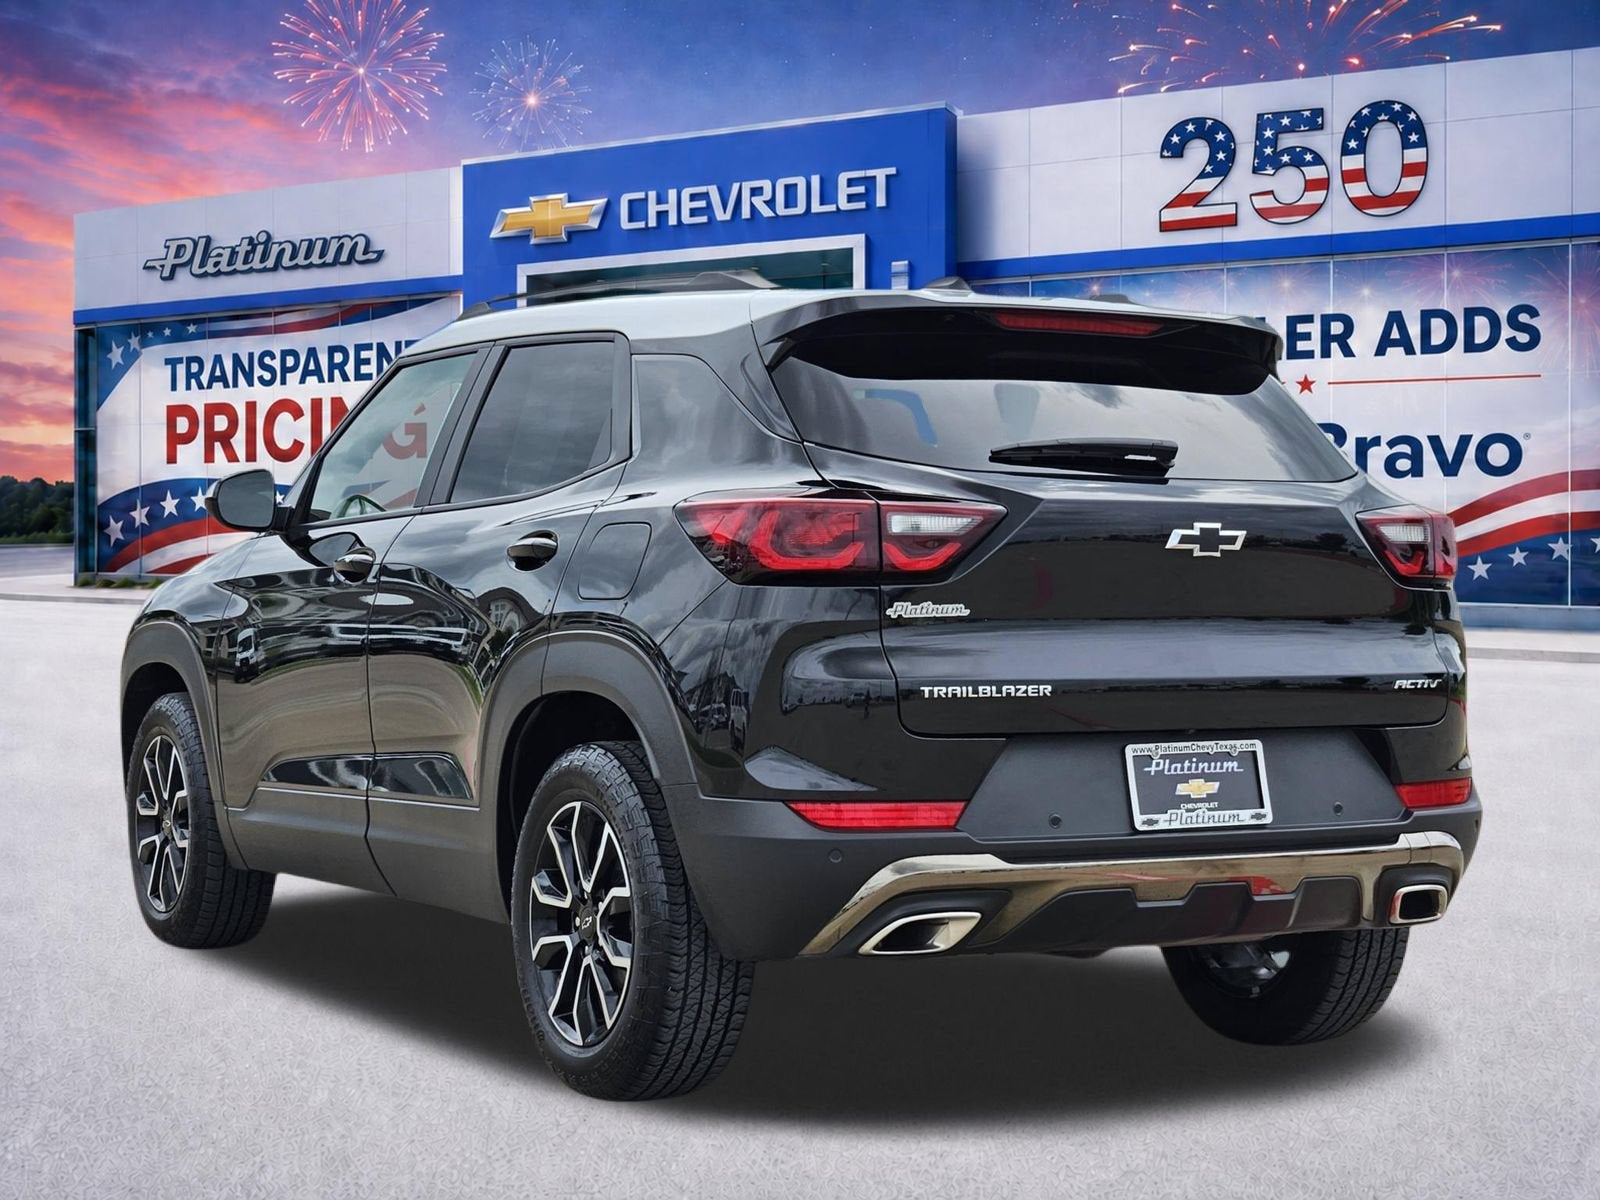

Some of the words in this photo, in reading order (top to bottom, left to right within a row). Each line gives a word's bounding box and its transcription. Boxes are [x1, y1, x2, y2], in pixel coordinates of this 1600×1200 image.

[1159, 99, 1429, 232] 250
[619, 167, 897, 230] CHEVROLET
[143, 230, 385, 281] Platinum
[1255, 313, 1356, 361] ER
[1374, 303, 1542, 357] ADDS
[164, 339, 421, 392] TRANSPAREN
[886, 602, 970, 619] Platinum
[920, 685, 1052, 699] TRAILBLAZER
[1393, 679, 1442, 689] ACTIV
[1132, 742, 1257, 755] www.PlatinumChevyTexas.com
[1144, 757, 1244, 776] Platinum
[1180, 801, 1219, 810] CHEVROLET
[1163, 809, 1246, 826] Platinum
